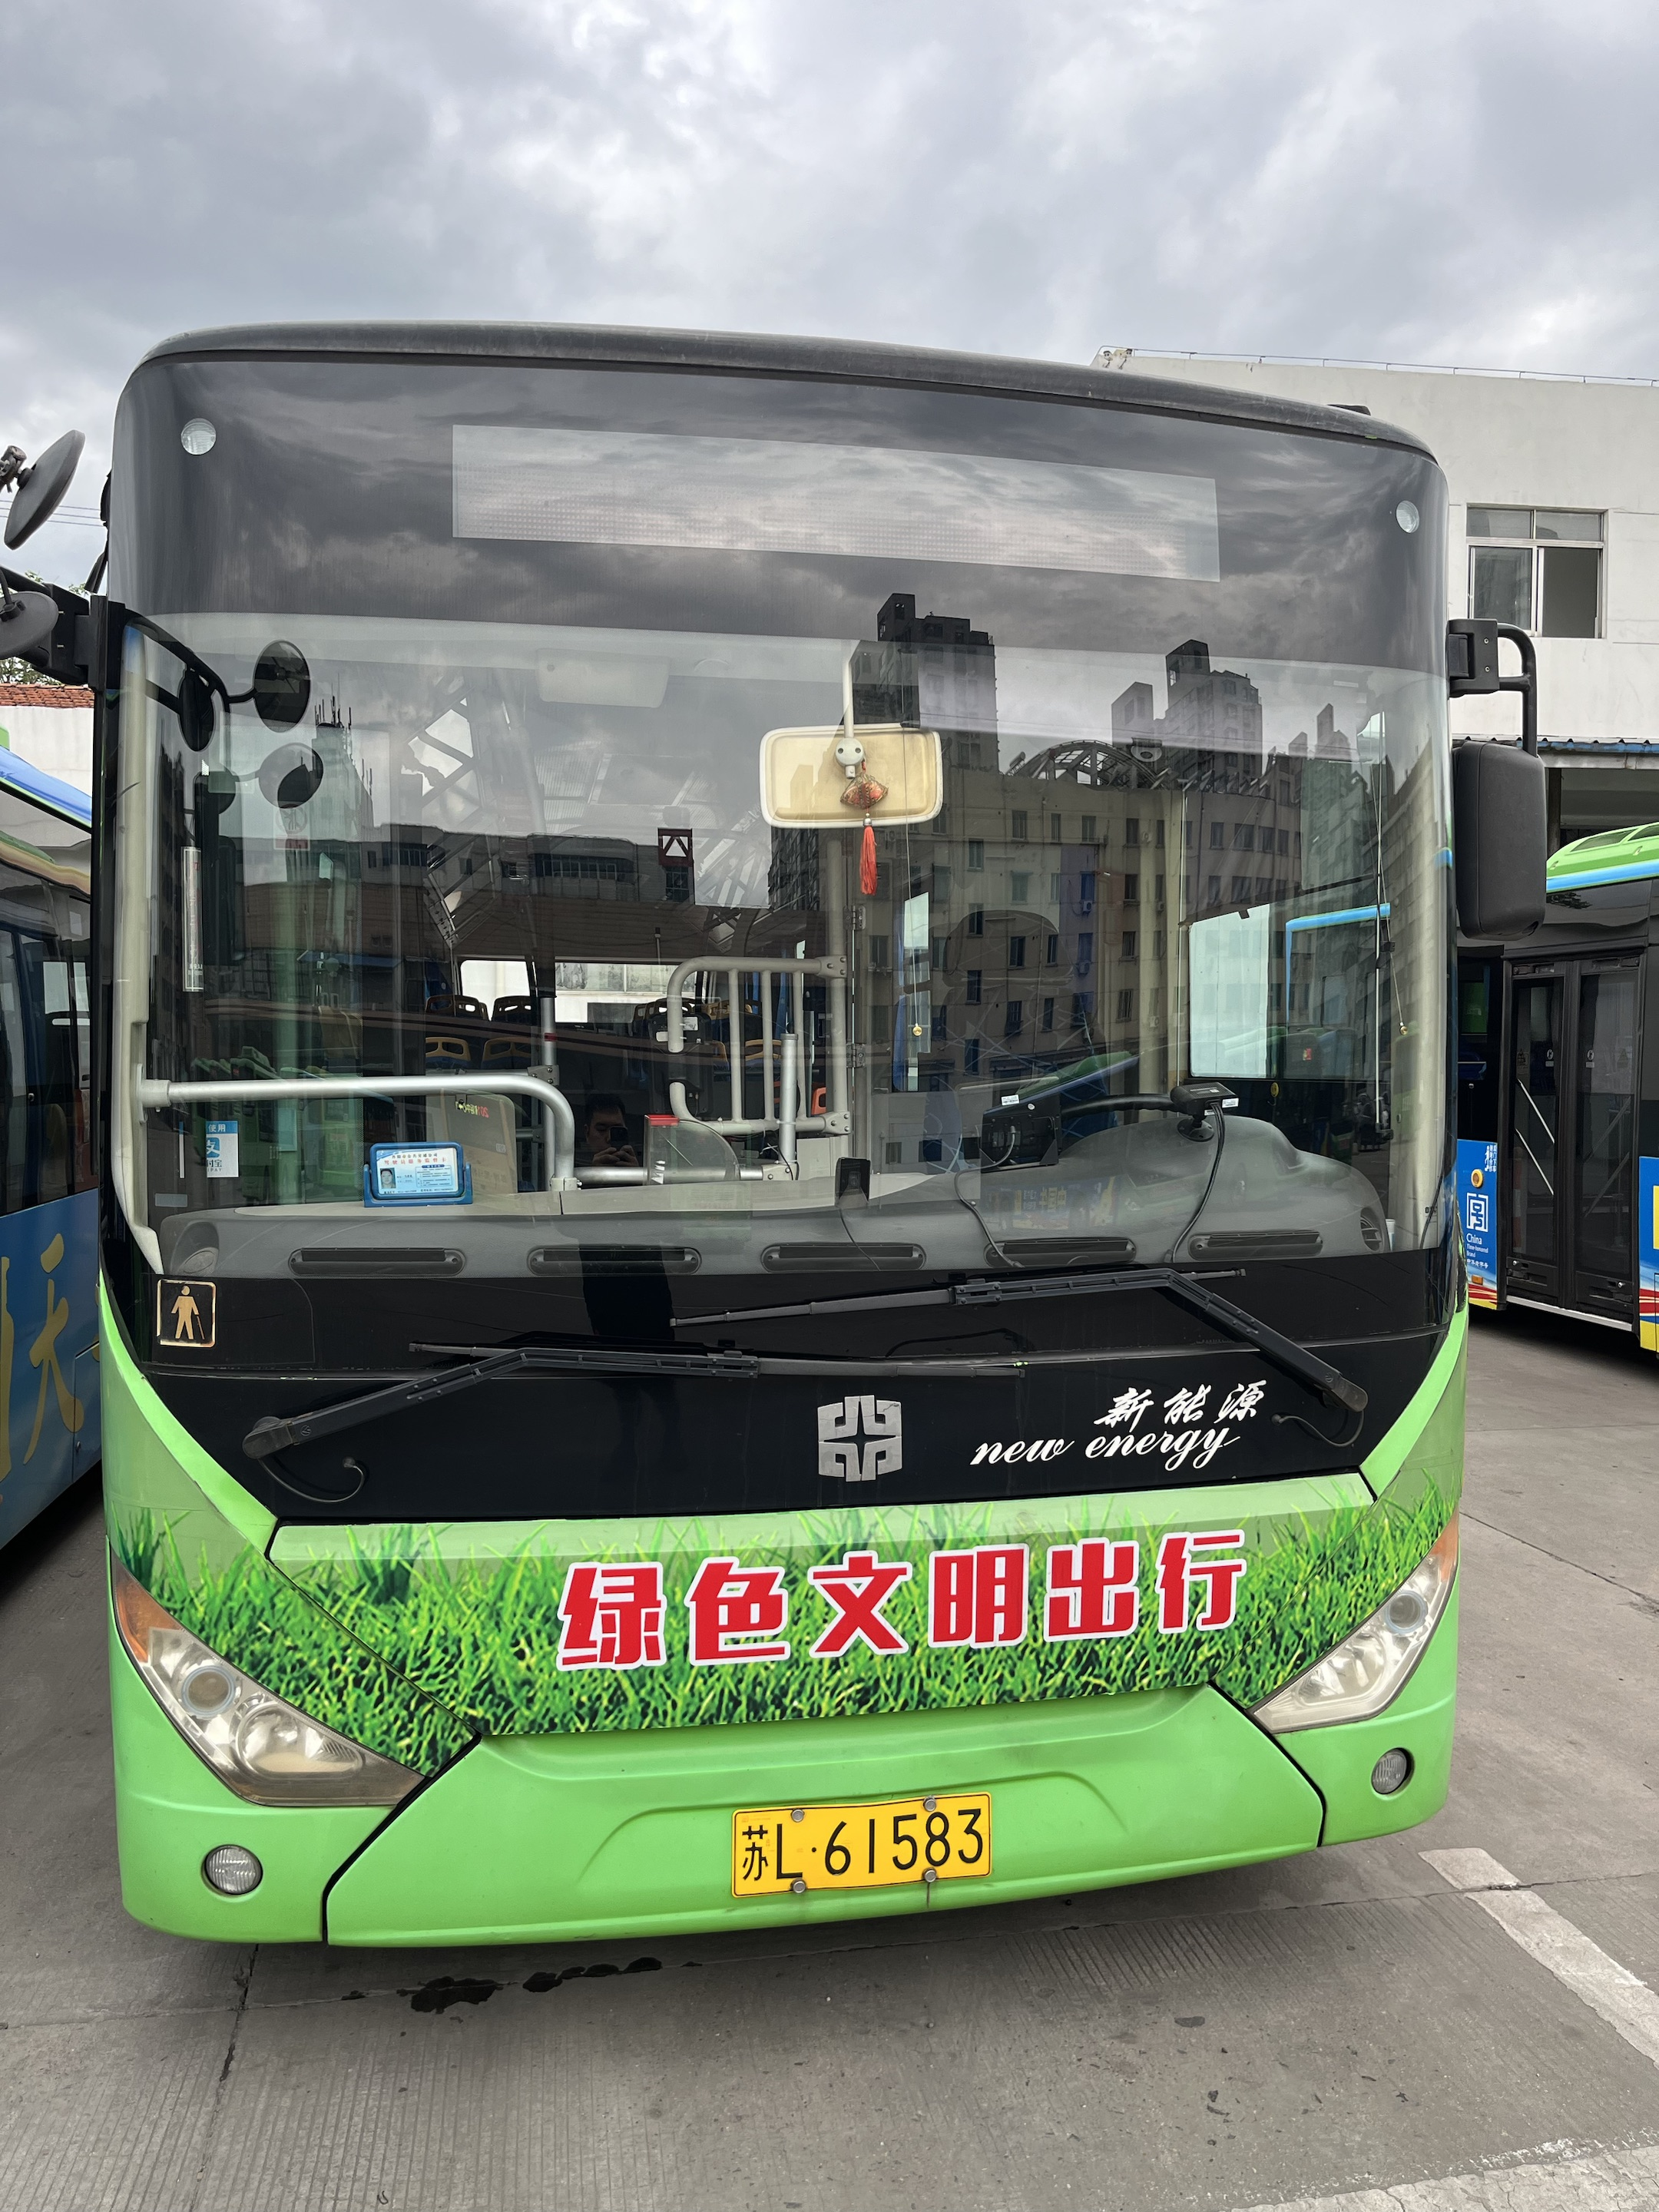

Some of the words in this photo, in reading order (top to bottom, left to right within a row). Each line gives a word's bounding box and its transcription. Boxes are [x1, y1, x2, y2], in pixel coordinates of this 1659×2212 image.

[208, 1124, 226, 1132] 使用
[1466, 1233, 1482, 1245] China
[1466, 1250, 1476, 1258] Brand
[1094, 1380, 1267, 1432] 新能源
[970, 1438, 1075, 1465] new
[1085, 1427, 1241, 1471] energy
[557, 1529, 1245, 1671] 绿色文明出行
